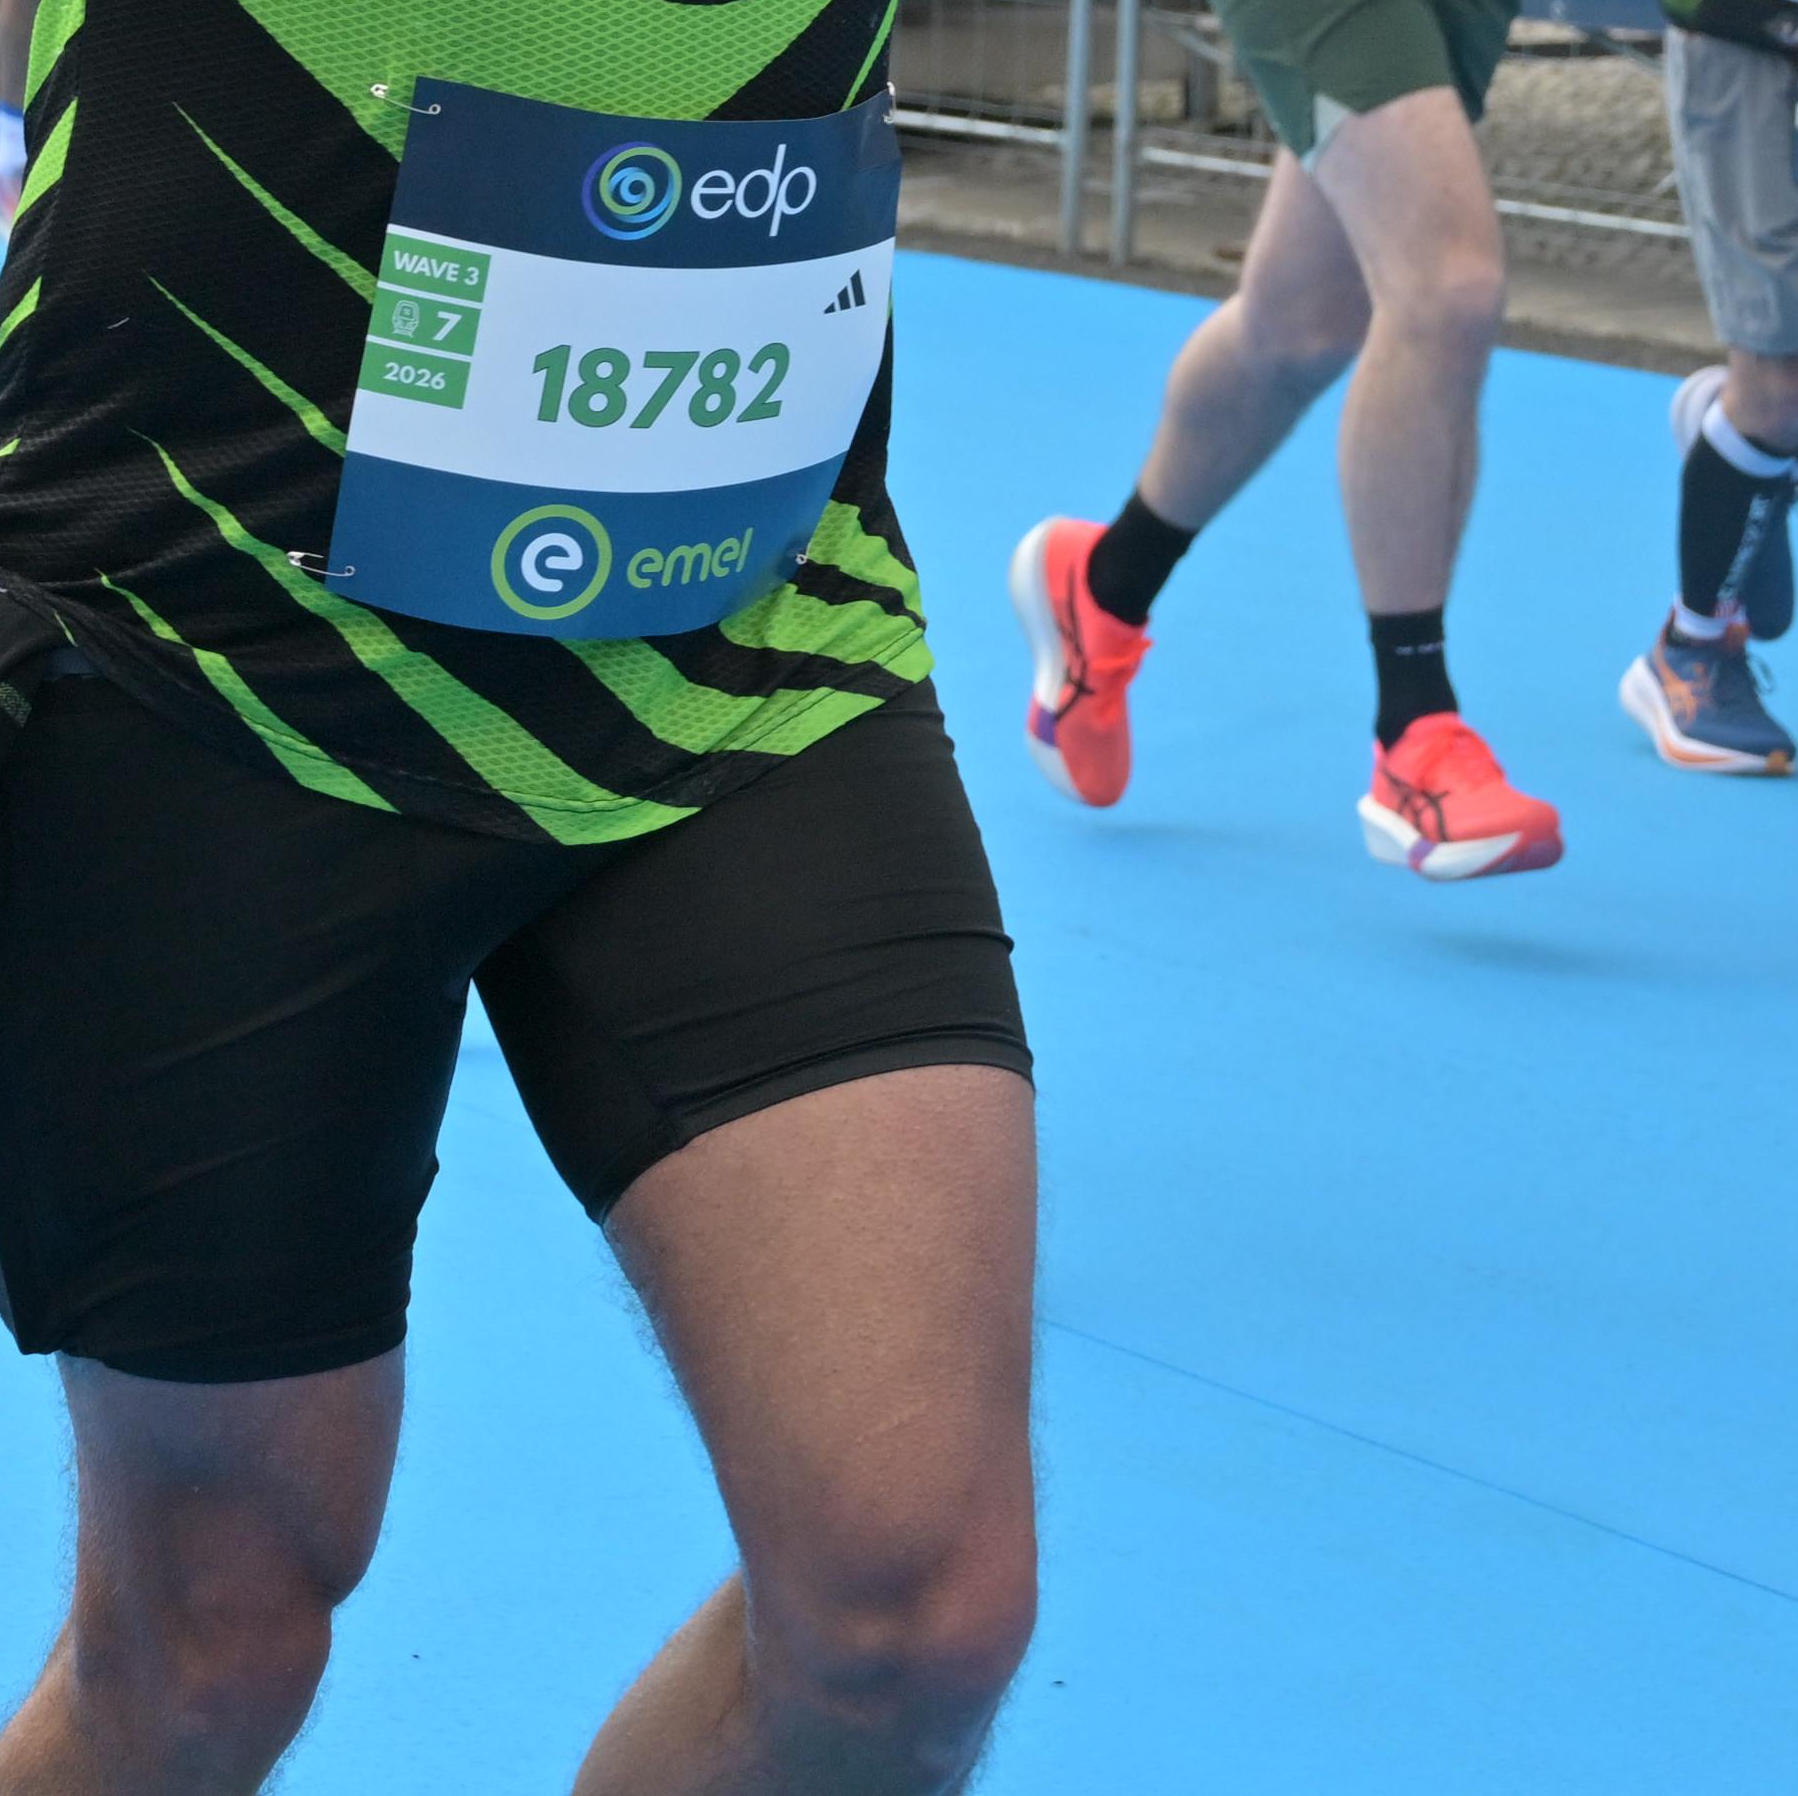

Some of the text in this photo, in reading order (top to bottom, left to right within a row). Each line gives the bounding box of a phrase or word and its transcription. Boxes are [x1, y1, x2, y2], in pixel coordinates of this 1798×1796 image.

[690, 143, 817, 237] edp
[392, 250, 480, 287] WAVE 3
[432, 310, 463, 342] 7
[382, 361, 447, 391] 2026
[532, 342, 791, 429] 18782
[625, 527, 755, 590] emel
